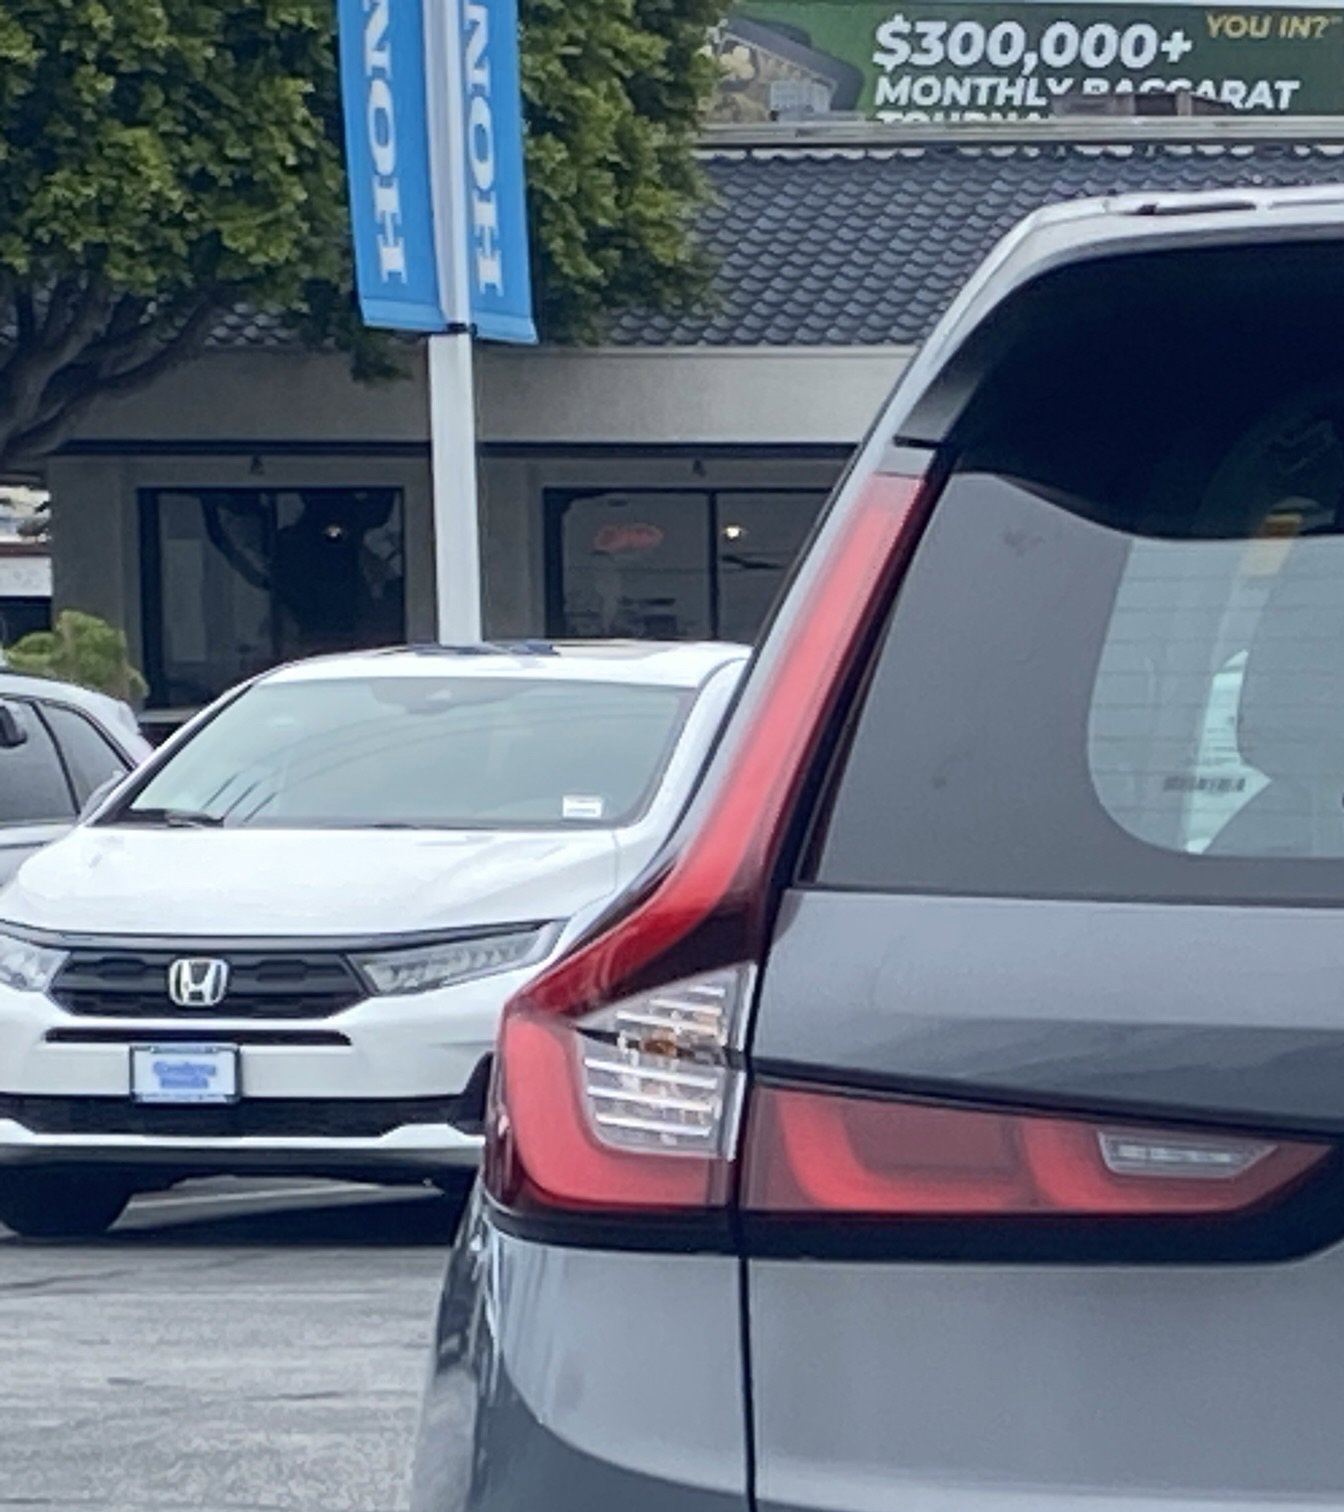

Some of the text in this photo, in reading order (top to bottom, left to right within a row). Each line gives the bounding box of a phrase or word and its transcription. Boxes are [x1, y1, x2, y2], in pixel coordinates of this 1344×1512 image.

[1206, 14, 1272, 39] YOU
[872, 13, 1194, 76] $300,000+
[874, 75, 1074, 106] MONTHLY
